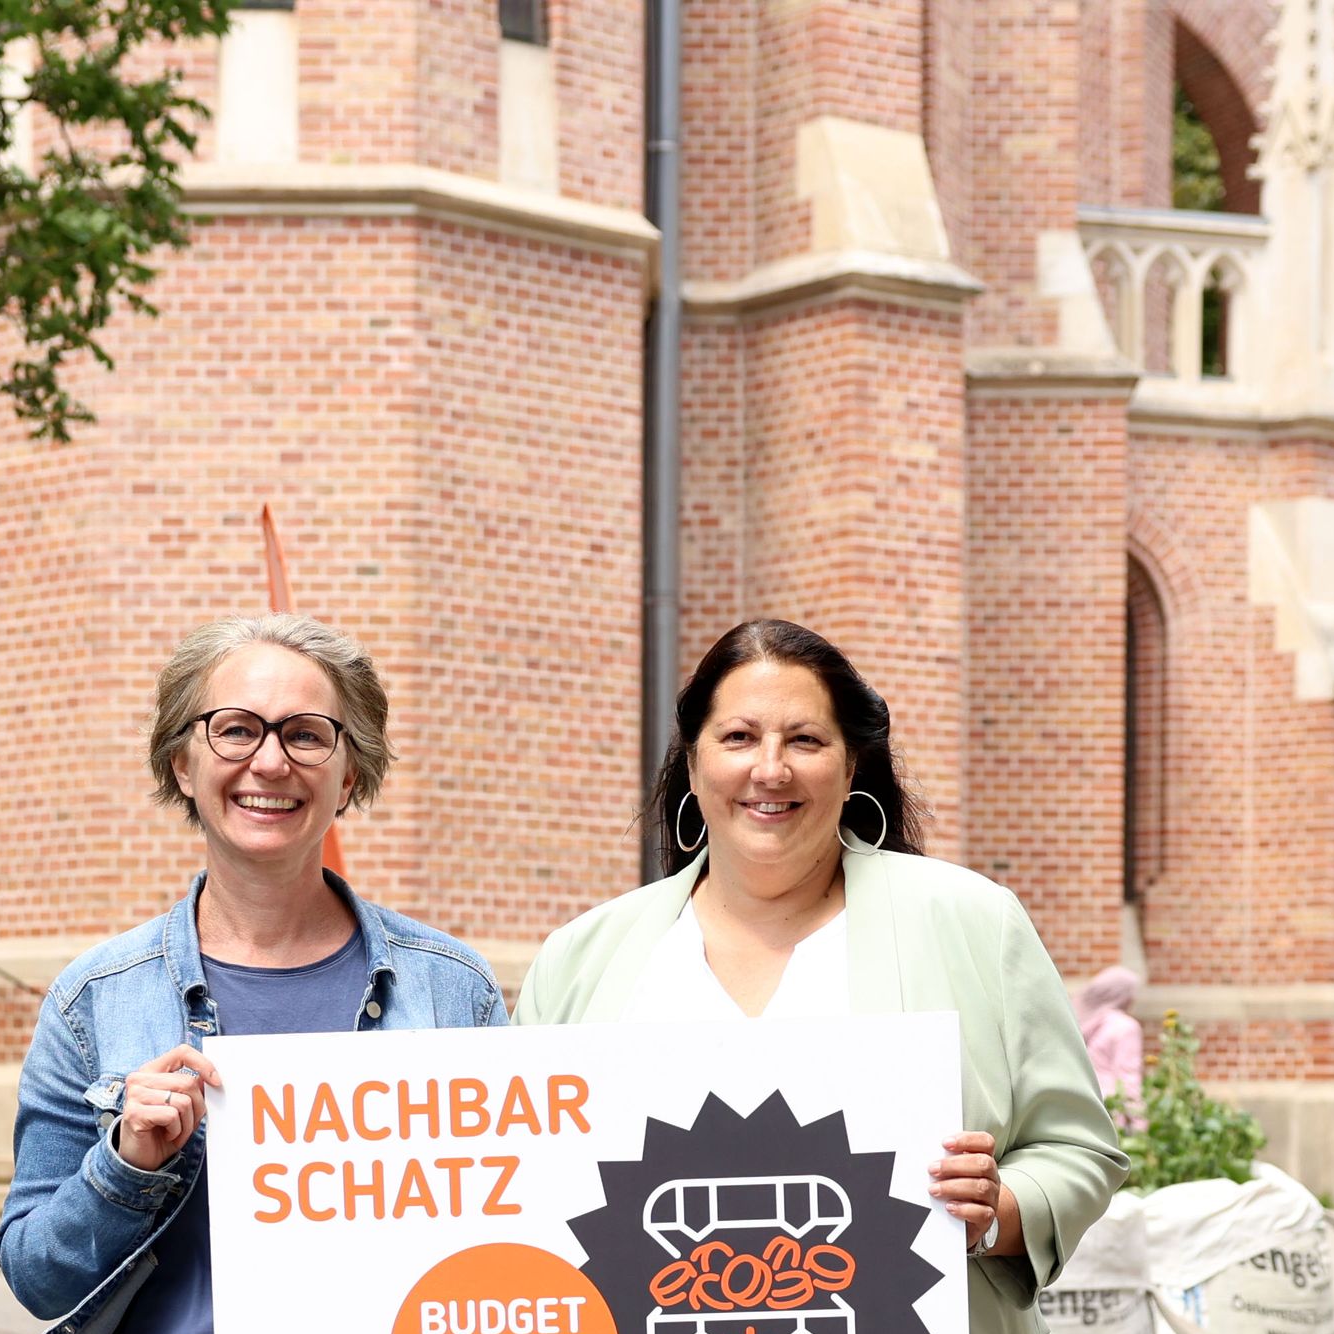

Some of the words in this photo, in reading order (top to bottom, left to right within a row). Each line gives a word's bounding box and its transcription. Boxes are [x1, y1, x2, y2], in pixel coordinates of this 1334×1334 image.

[252, 1075, 591, 1144] NACHBAR
[253, 1156, 522, 1223] SCHATZ
[1237, 1248, 1327, 1288] enge
